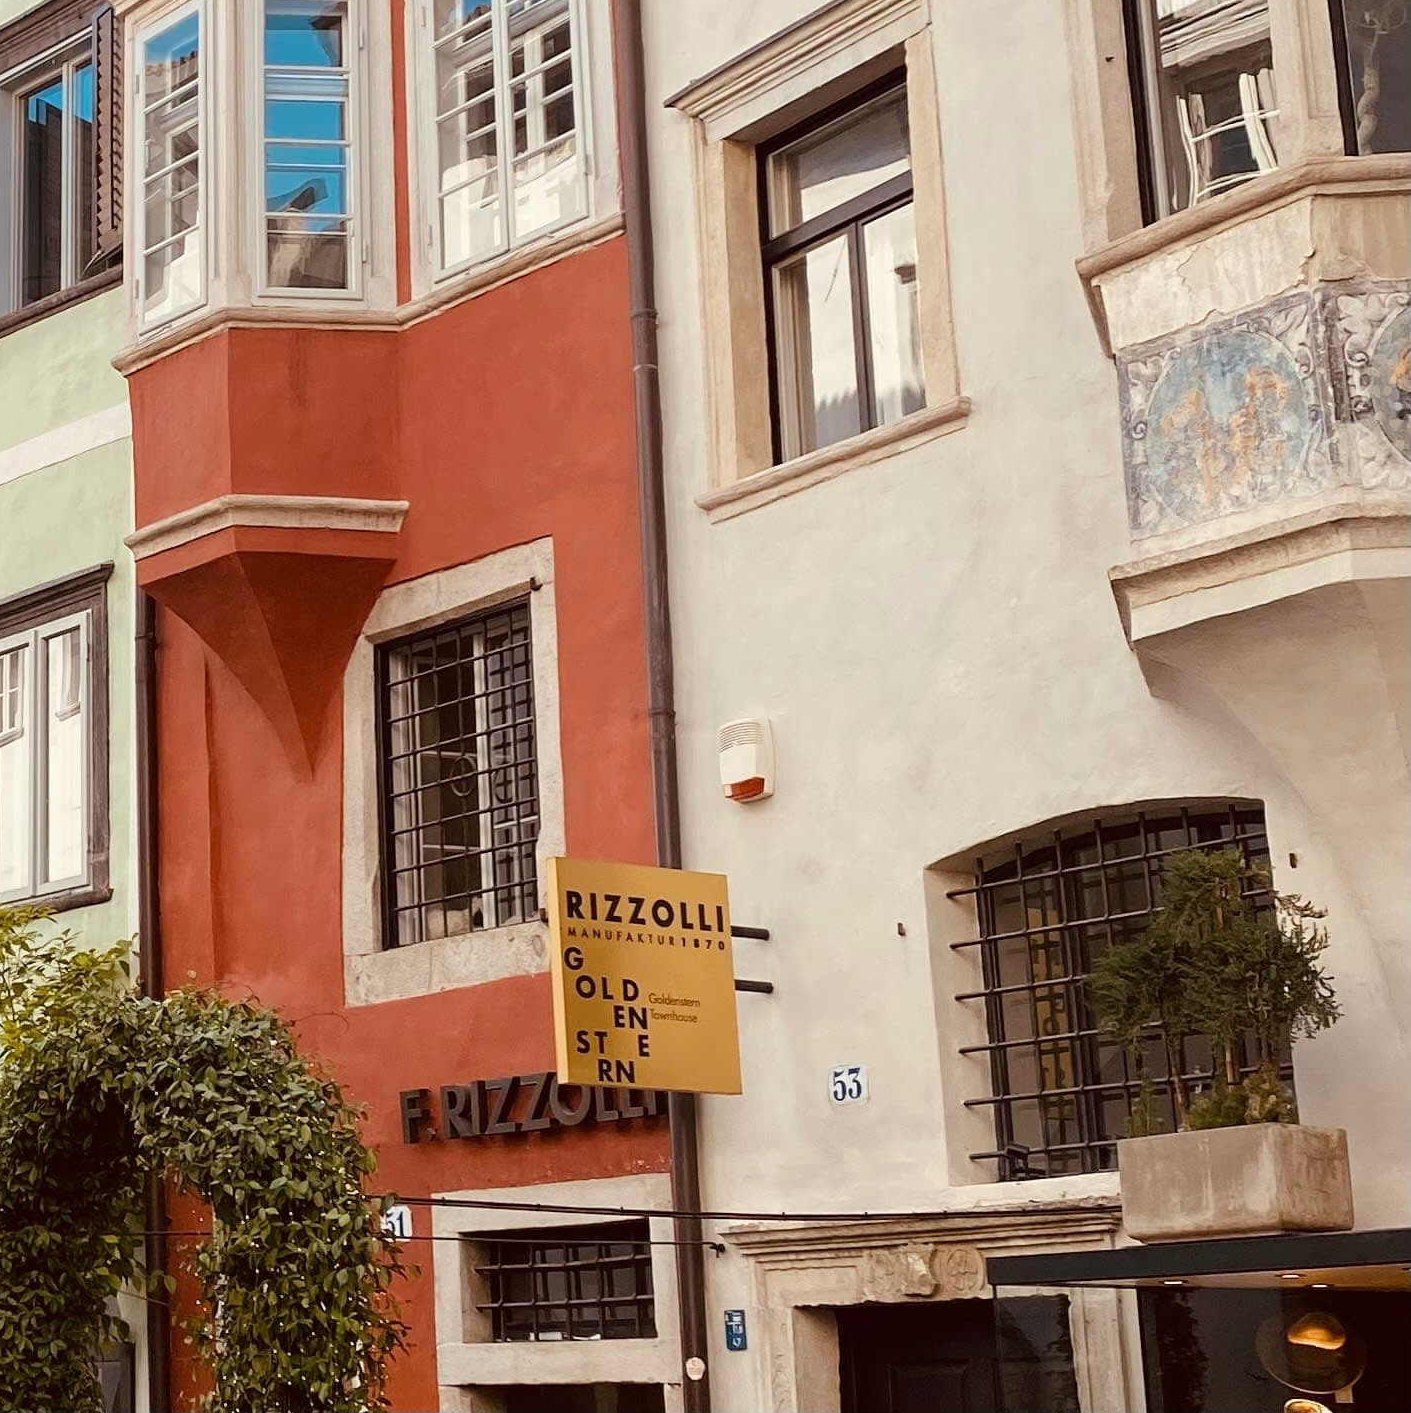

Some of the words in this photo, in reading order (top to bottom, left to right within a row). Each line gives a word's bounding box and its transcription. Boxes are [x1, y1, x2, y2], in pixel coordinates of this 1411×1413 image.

[566, 890, 724, 932] RIZZOLLI
[567, 926, 675, 946] MANUFAKTUR
[564, 946, 584, 970] G
[648, 992, 700, 1007] Goldenstern
[650, 1008, 698, 1023] Townhouse
[833, 1067, 862, 1101] 53
[385, 1211, 405, 1236] 51
